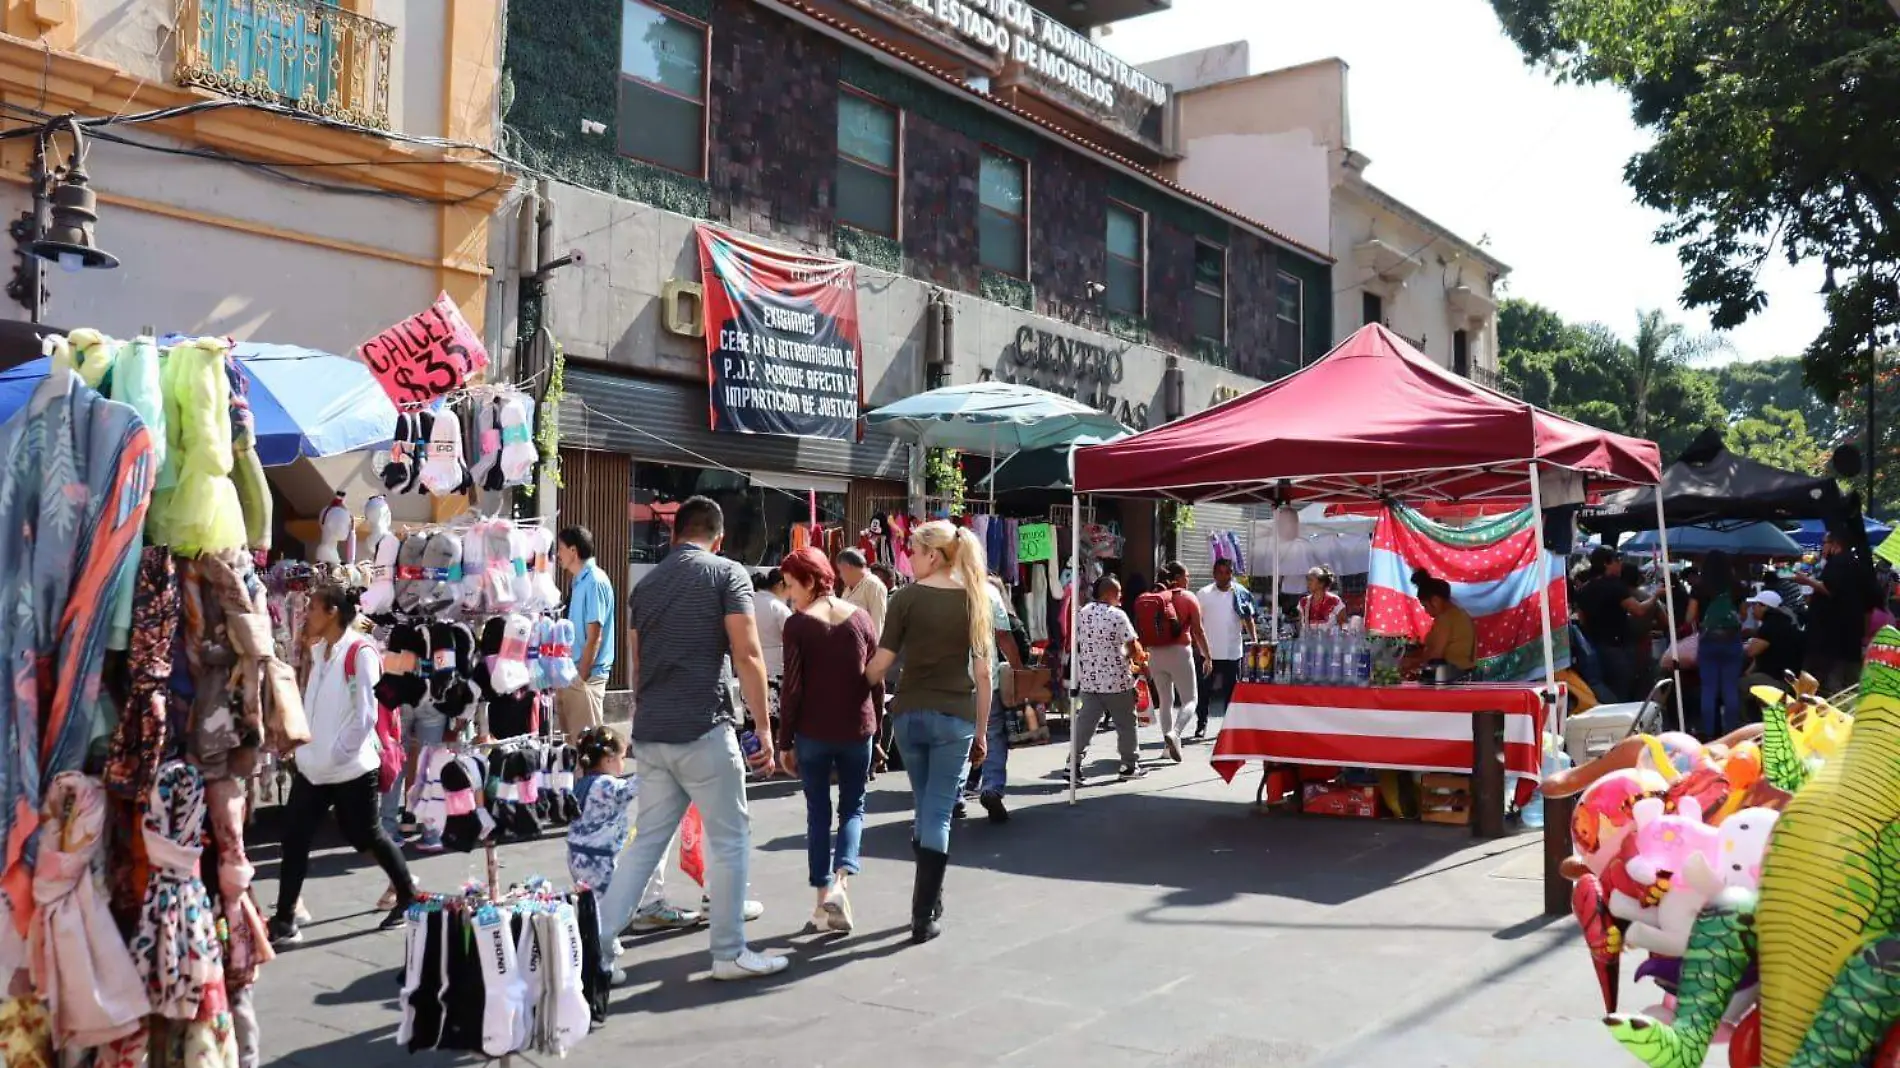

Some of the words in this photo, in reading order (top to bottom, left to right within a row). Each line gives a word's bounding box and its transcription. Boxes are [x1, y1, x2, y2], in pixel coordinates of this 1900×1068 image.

[934, 0, 1010, 53] ESTADO
[1013, 34, 1038, 67] DE
[1038, 48, 1114, 107] MORELOS
[1041, 19, 1167, 106] ADMINISTRATIVA
[763, 305, 816, 335] EXIGIMOS
[720, 329, 750, 353] CESE
[752, 334, 761, 355] A
[762, 337, 777, 358] LA
[778, 341, 845, 367] INTROMISIÓN
[1015, 325, 1123, 385] CENTRO
[764, 362, 805, 389] PORQUE
[806, 369, 843, 393] AFECTA
[725, 385, 800, 413] IMPARTICIÓN
[801, 395, 816, 415] DE
[492, 929, 507, 975] UNDER
